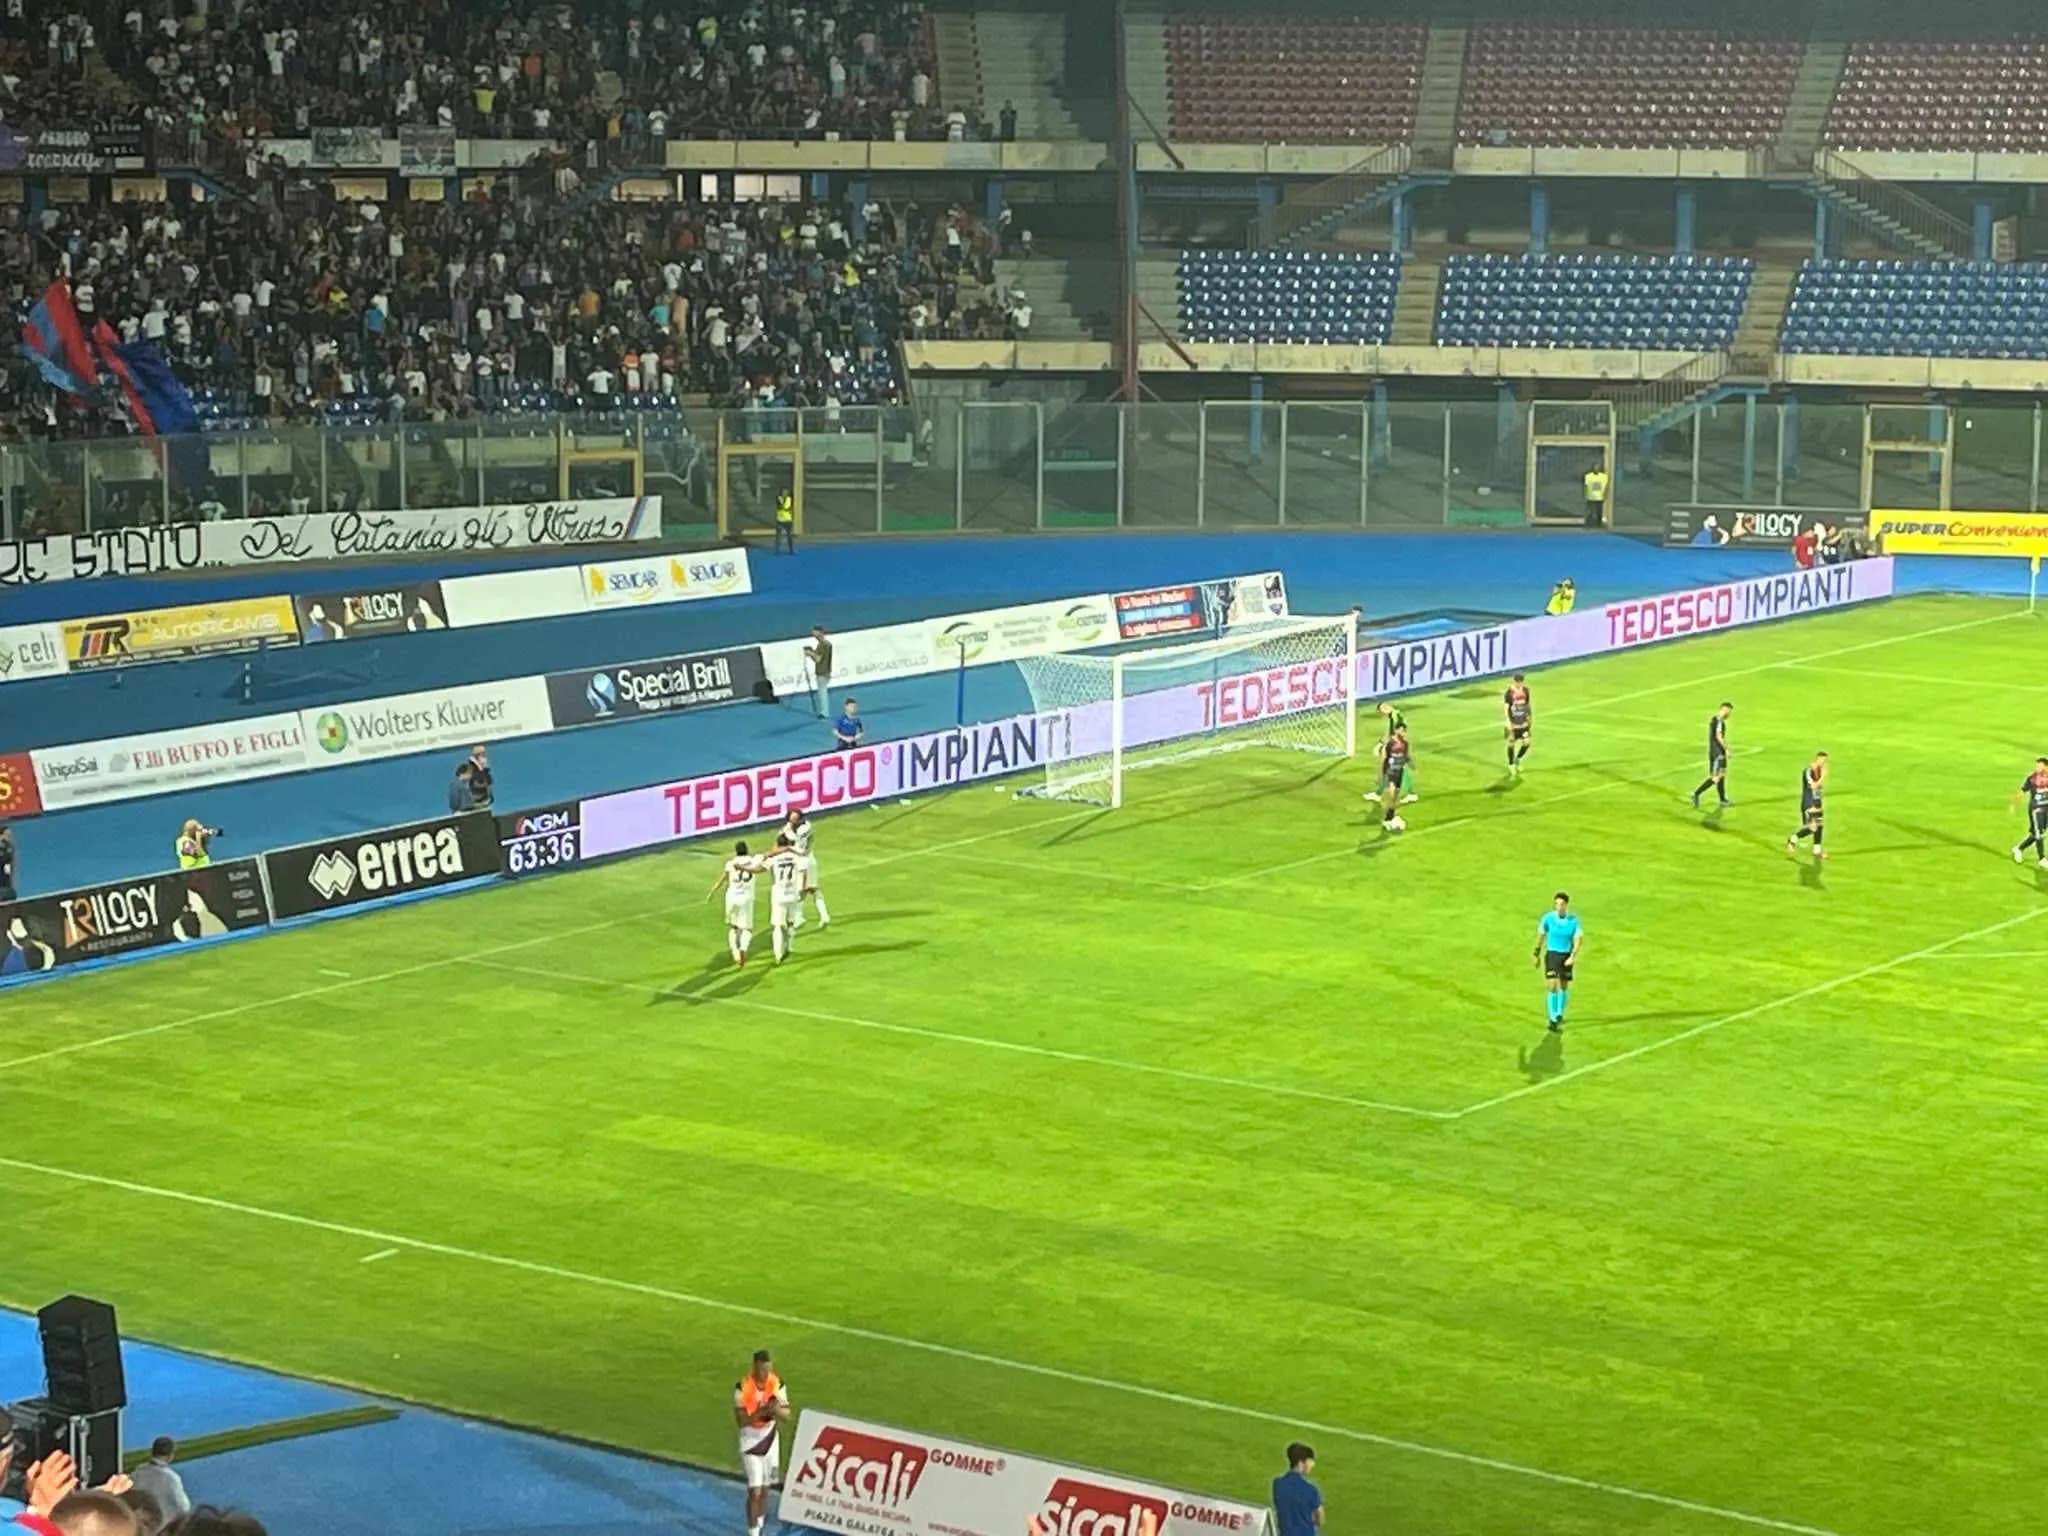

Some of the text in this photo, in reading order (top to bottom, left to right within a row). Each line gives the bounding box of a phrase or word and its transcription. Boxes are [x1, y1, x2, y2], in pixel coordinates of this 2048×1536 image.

[240, 516, 312, 559] Del
[331, 508, 459, 554] Catania
[1732, 512, 1802, 536] TRILOGY
[1881, 521, 1947, 535] SUPER
[343, 591, 404, 625] TRILOGY
[1606, 565, 1854, 647] TEDESCO IMPIANTI
[17, 631, 57, 664] celi
[618, 662, 690, 702] Special
[692, 657, 731, 689] Brill
[1198, 631, 1508, 729] TEDESCO IMPIANTI
[350, 709, 433, 740] Wolters
[436, 699, 505, 727] Kluwer
[166, 740, 229, 767] BUFFO
[232, 737, 247, 755] E
[249, 727, 301, 752] FIGLI
[42, 757, 99, 782] UnipolSai
[664, 712, 1072, 835] TEDESCO IMPIANTI
[521, 811, 569, 834] NGM
[509, 832, 575, 872] 63:36
[778, 862, 795, 881] 77
[59, 884, 160, 948] TRILOGY
[796, 1443, 917, 1507] sicali
[804, 1507, 843, 1526] PIAZZA
